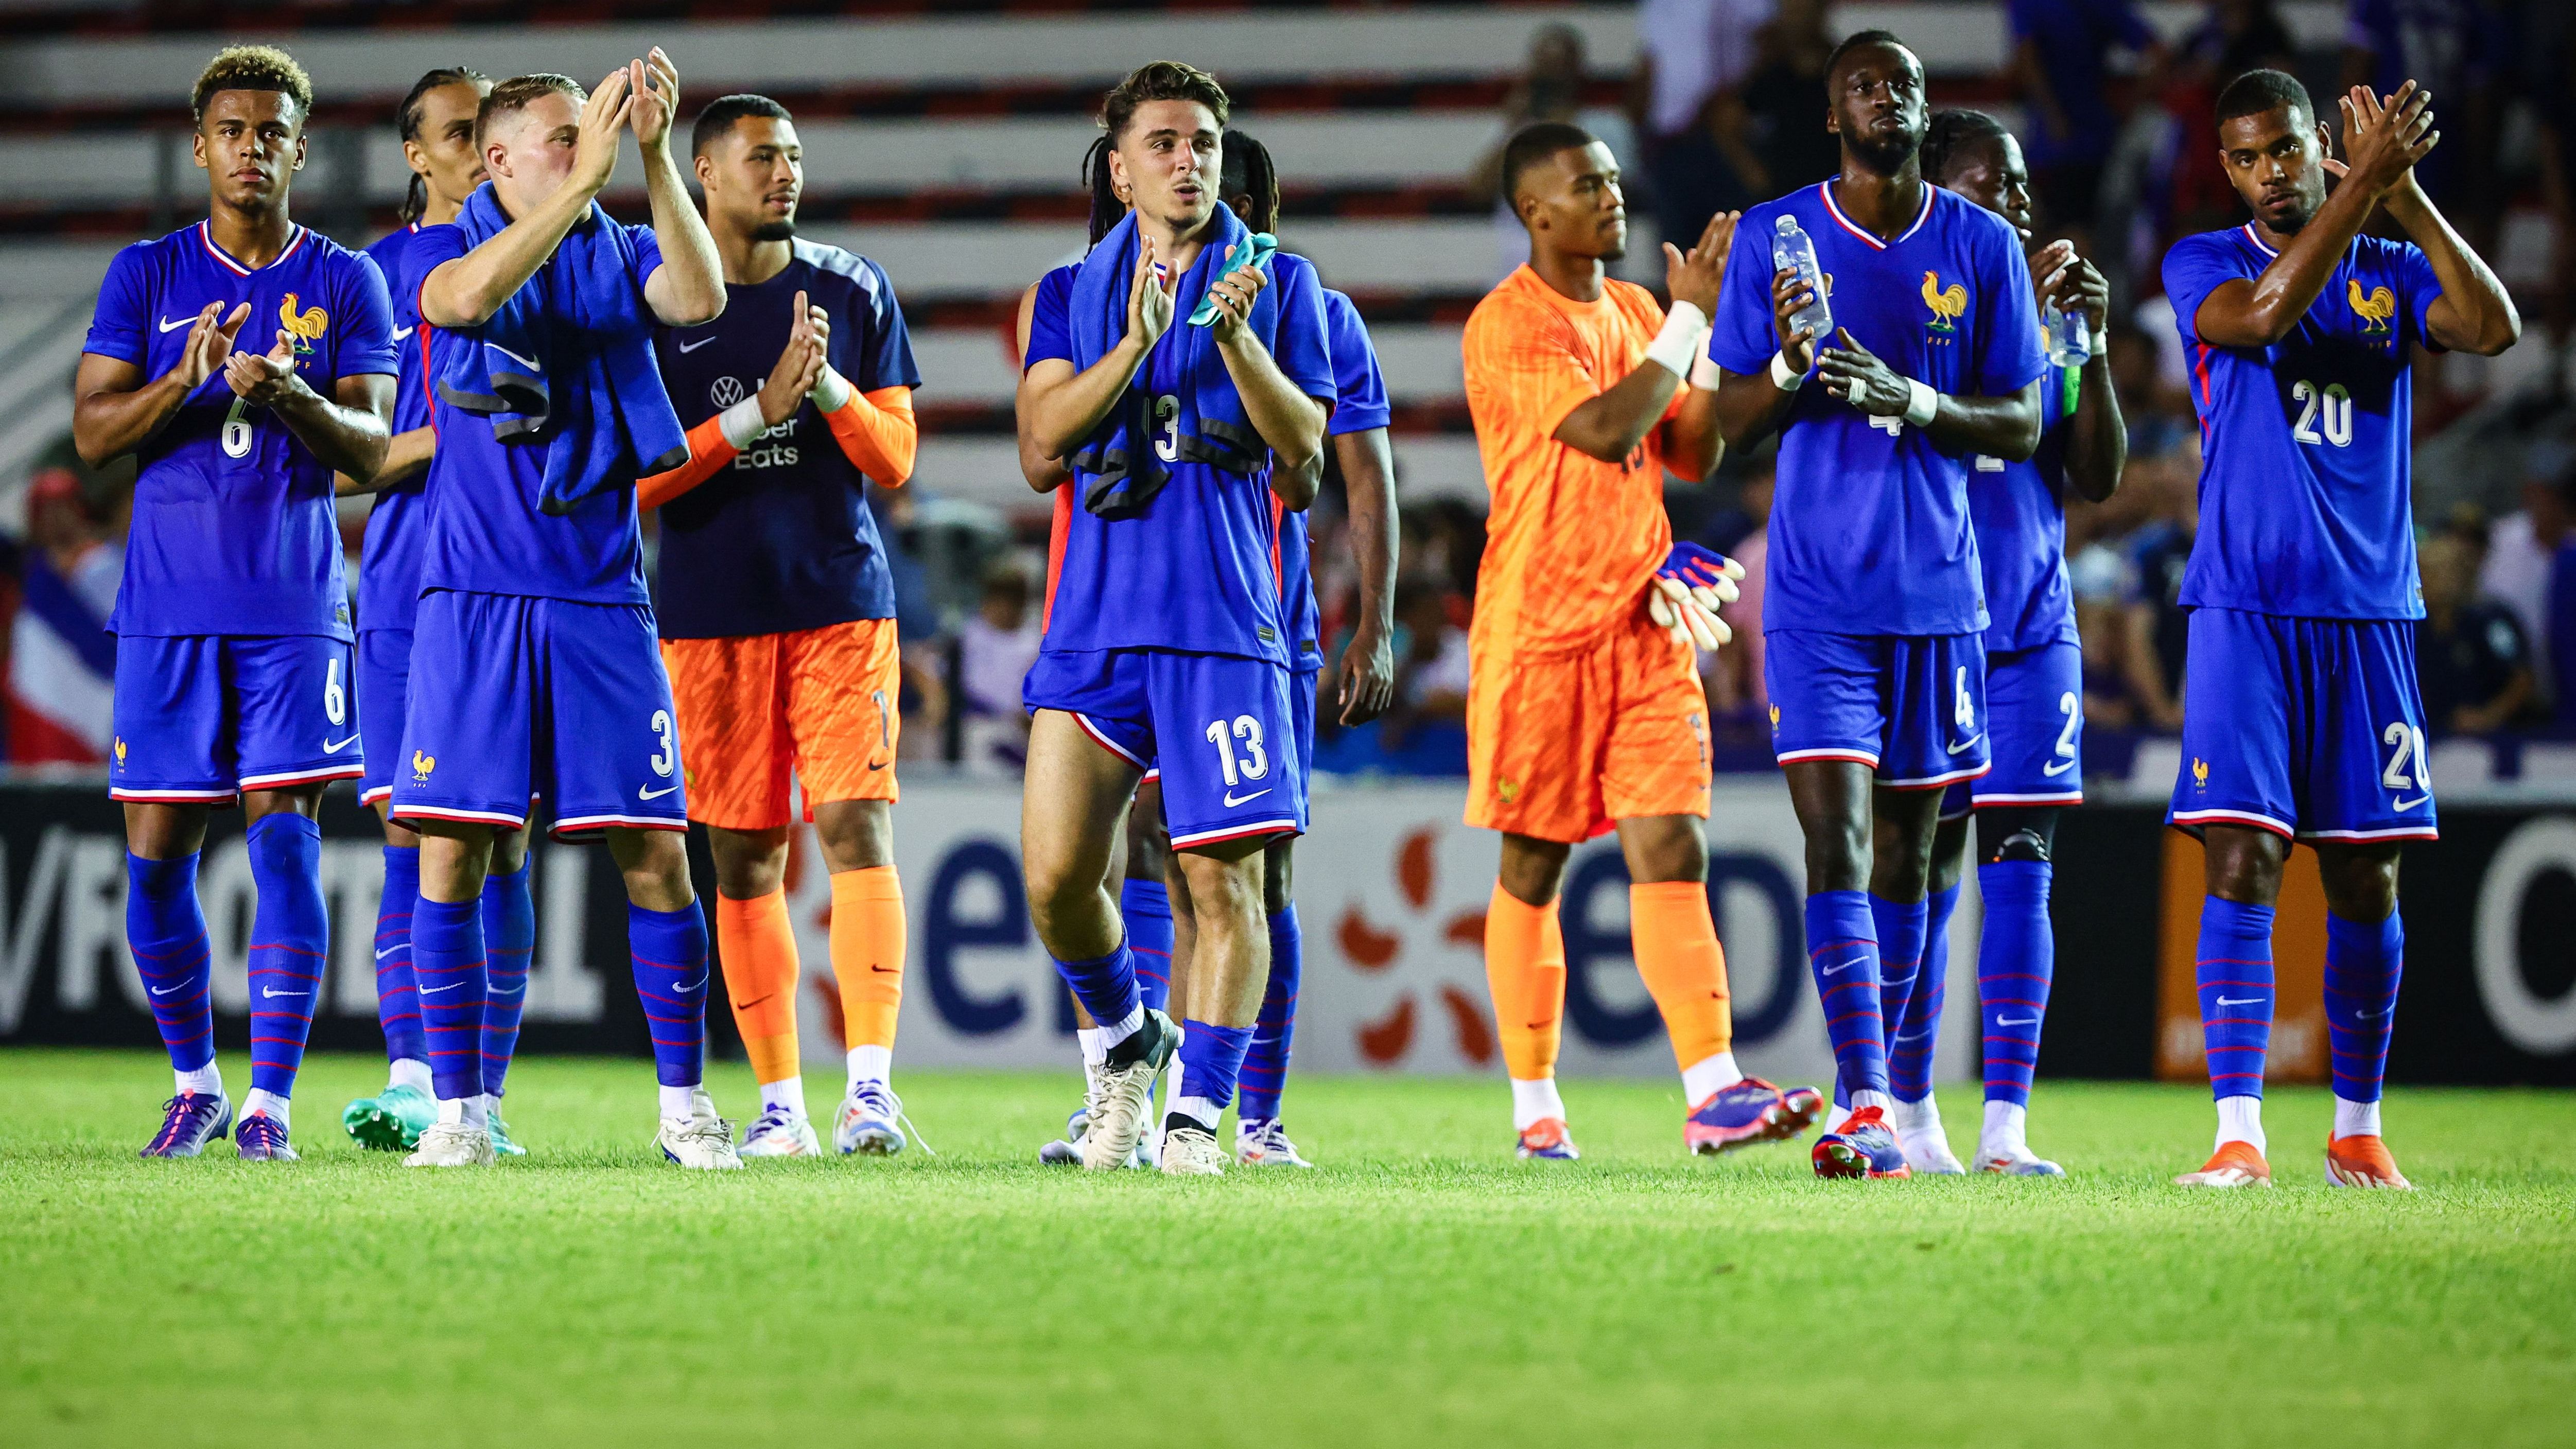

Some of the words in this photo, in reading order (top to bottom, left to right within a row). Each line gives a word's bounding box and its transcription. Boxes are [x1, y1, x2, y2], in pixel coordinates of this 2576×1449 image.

[294, 360, 310, 369] FF
[222, 395, 252, 458] 6
[2292, 379, 2352, 448] 20
[324, 658, 345, 726] 6
[1955, 666, 1975, 729] 4
[2055, 691, 2078, 758] 2
[651, 709, 674, 778] 3
[1206, 714, 1269, 787] 13
[2382, 722, 2431, 792] 20
